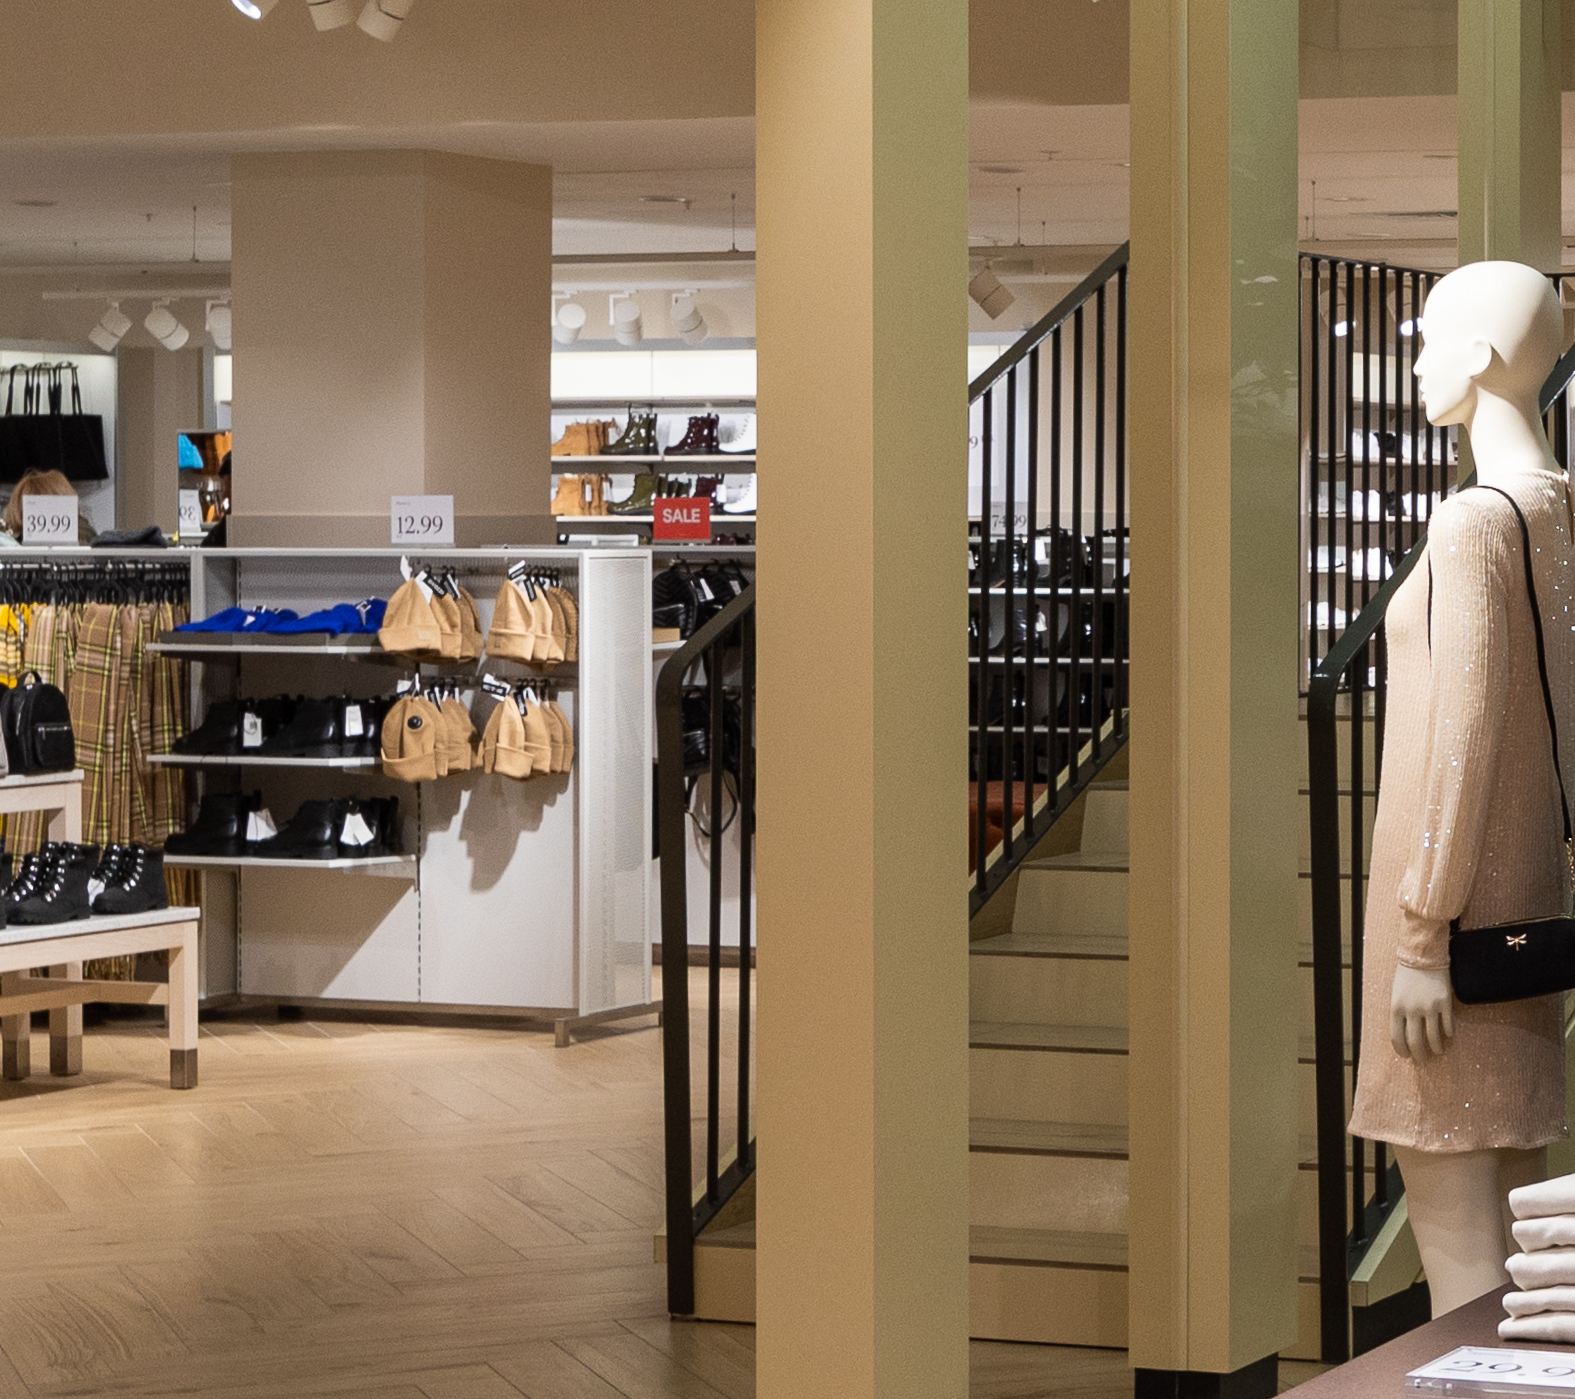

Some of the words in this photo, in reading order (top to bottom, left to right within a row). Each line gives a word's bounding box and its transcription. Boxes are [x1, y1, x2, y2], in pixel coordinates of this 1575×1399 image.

[26, 514, 71, 534] 39.99
[397, 515, 444, 534] 12.99
[662, 507, 701, 524] SALE
